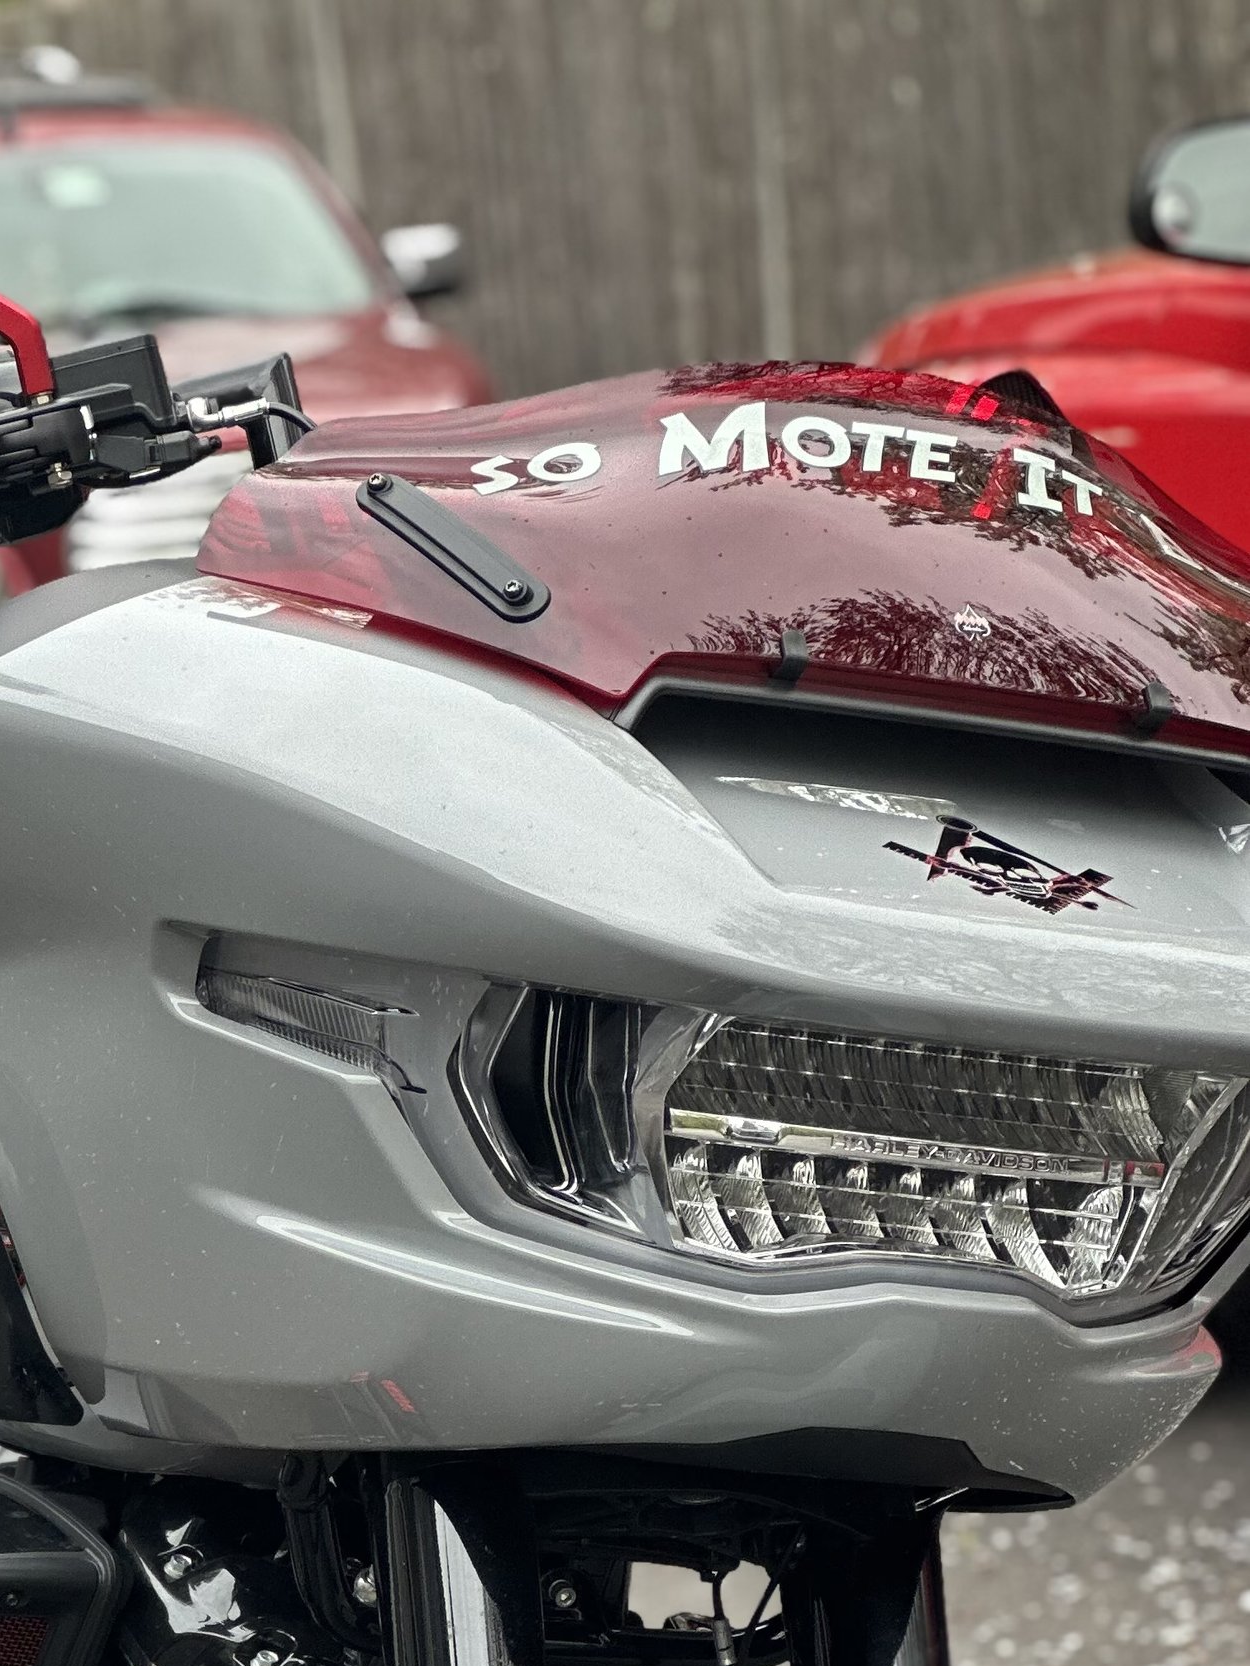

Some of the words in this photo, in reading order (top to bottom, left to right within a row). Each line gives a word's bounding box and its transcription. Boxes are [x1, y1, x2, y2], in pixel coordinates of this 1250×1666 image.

[470, 442, 601, 496] SO
[658, 401, 958, 483] MOTE
[1013, 447, 1103, 516] IT
[831, 1134, 1069, 1173] HARLEY-DAVIDSON
